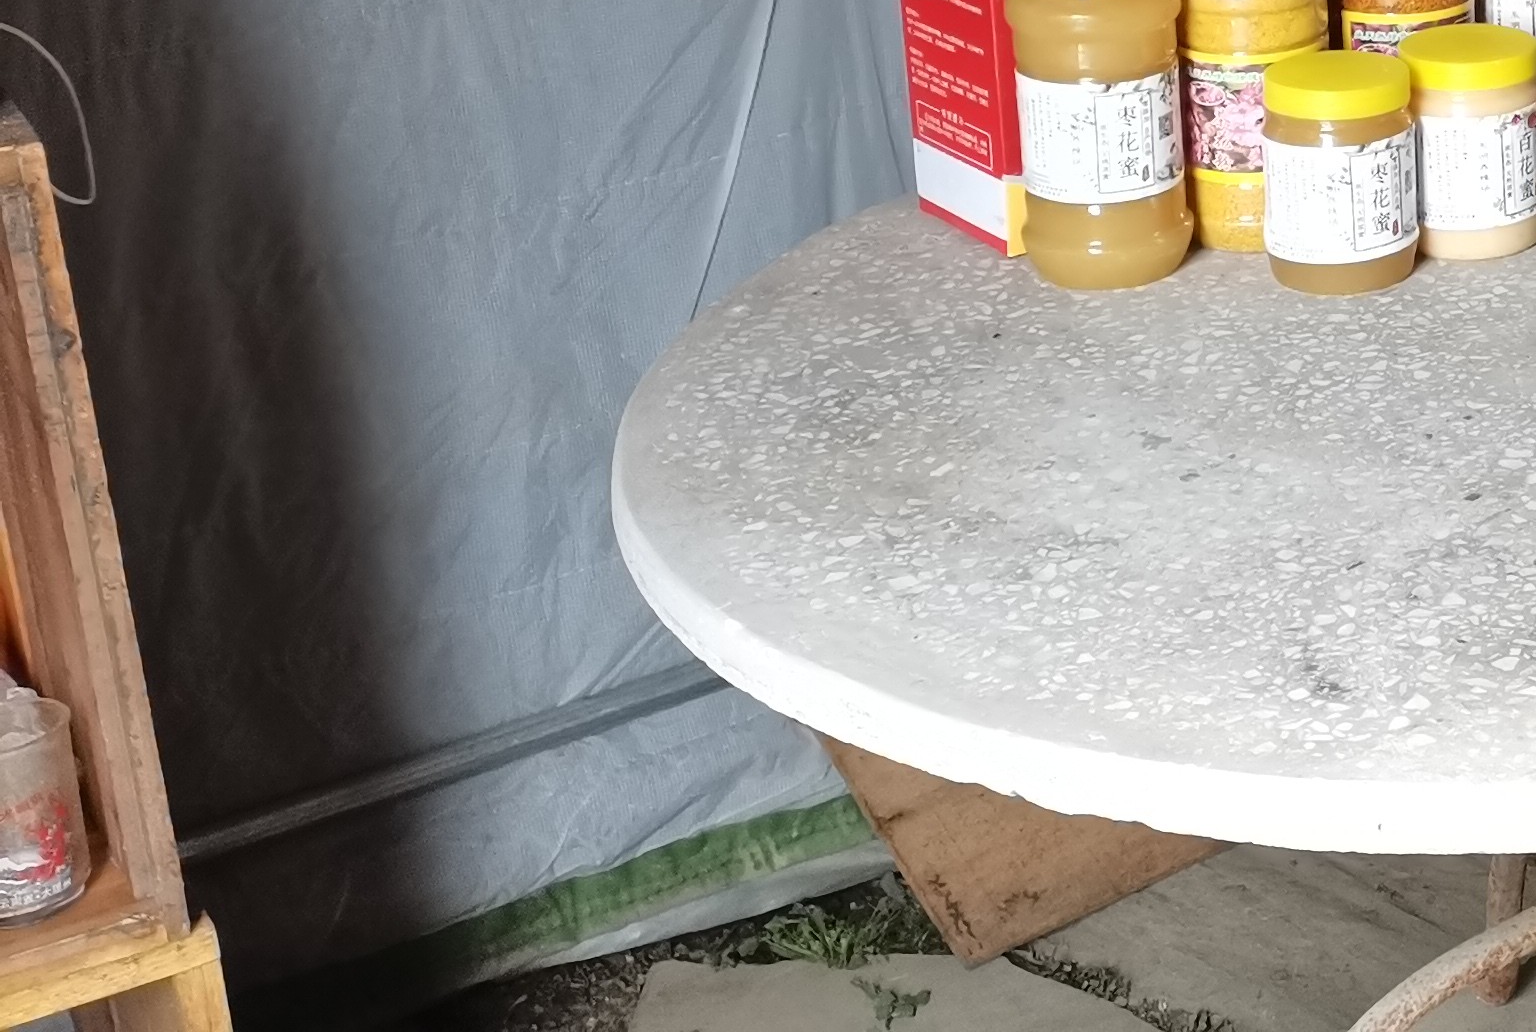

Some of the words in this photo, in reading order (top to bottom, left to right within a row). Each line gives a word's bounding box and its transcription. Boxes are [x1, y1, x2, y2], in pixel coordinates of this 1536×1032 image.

[1117, 105, 1140, 179] 枣花蜜
[1519, 131, 1535, 202] 百花蜜
[1370, 162, 1391, 236] 枣花蜜
